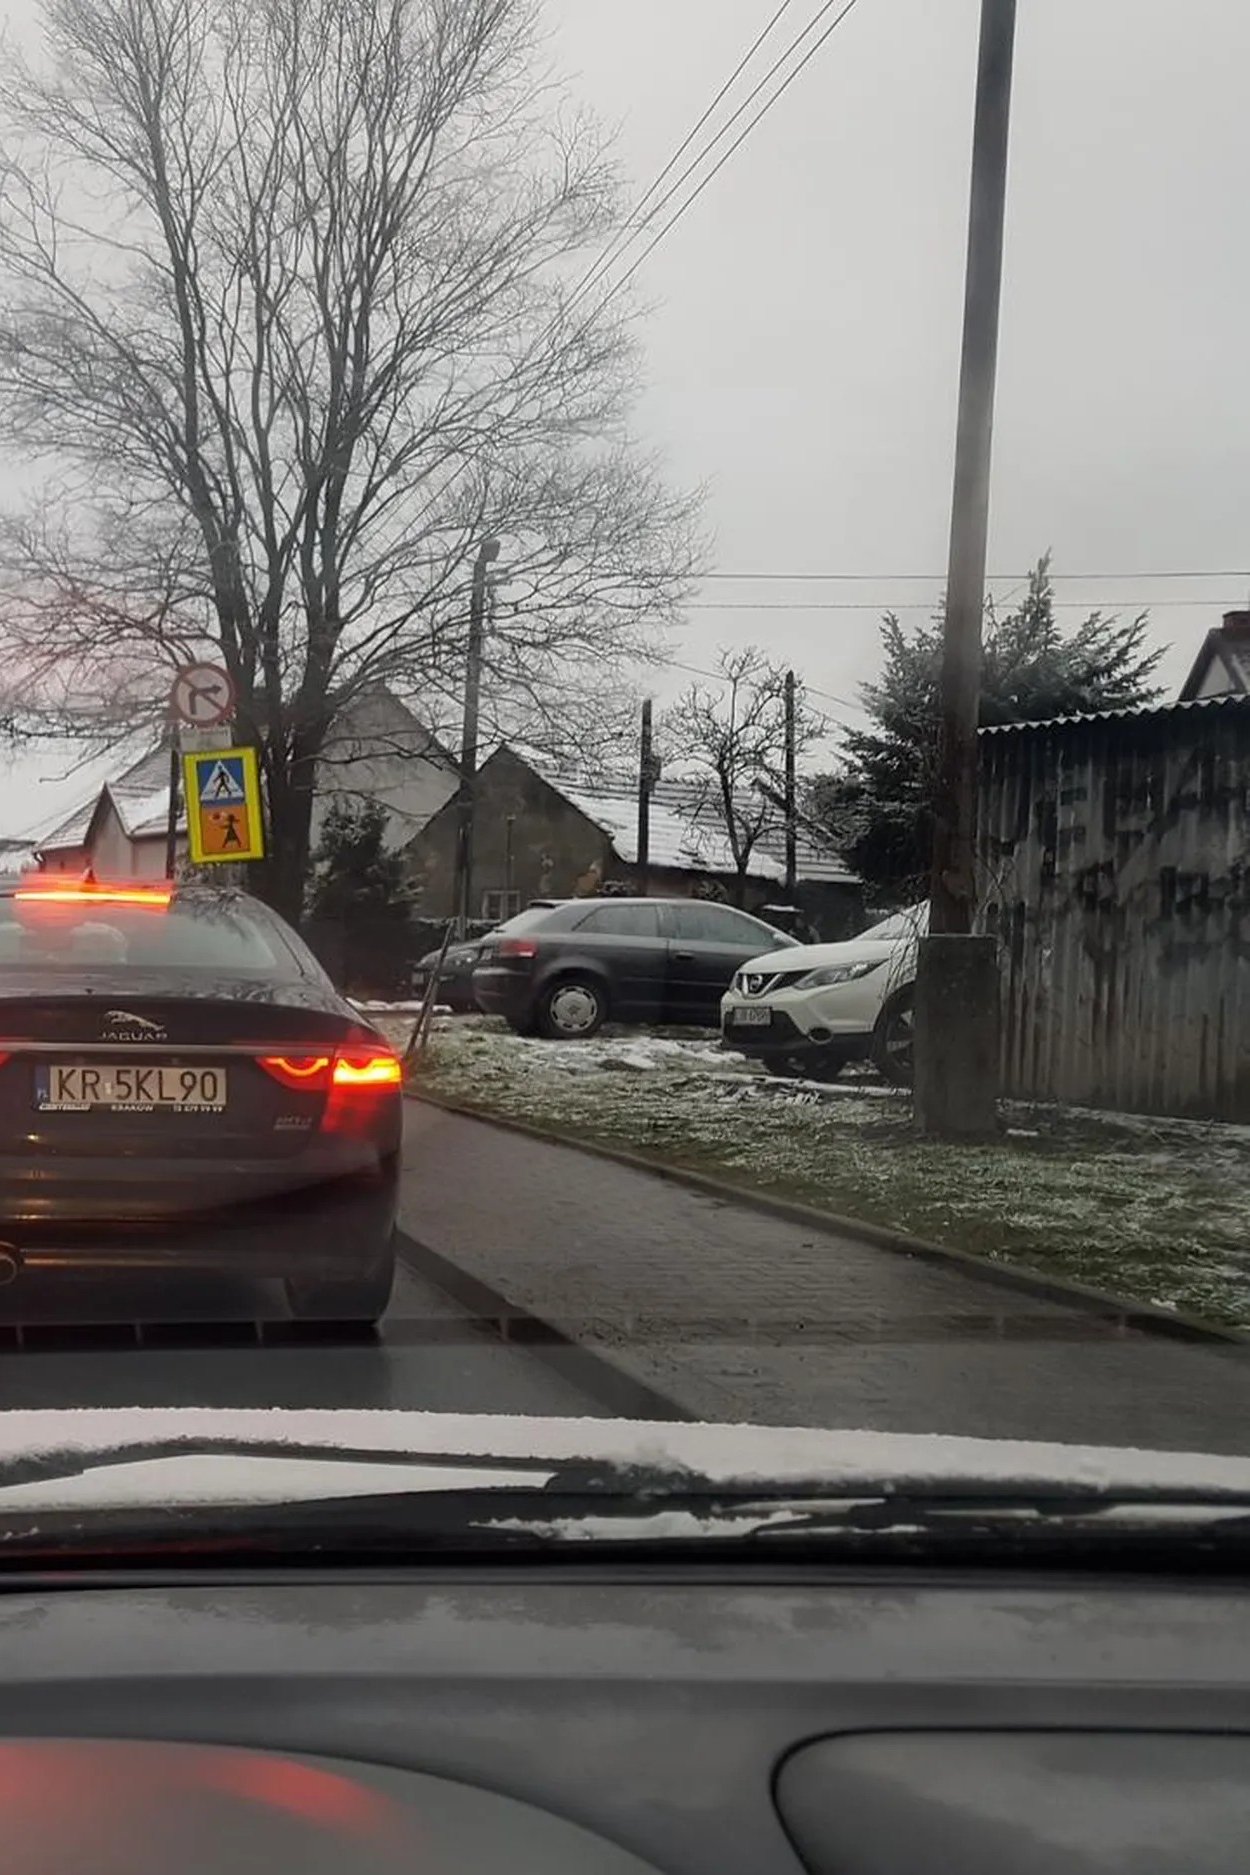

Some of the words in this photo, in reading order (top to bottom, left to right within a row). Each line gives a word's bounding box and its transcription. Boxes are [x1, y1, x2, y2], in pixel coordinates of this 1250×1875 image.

[97, 1031, 168, 1041] JAGUAR
[57, 1068, 101, 1102] KR
[115, 1069, 218, 1103] 5KL90
